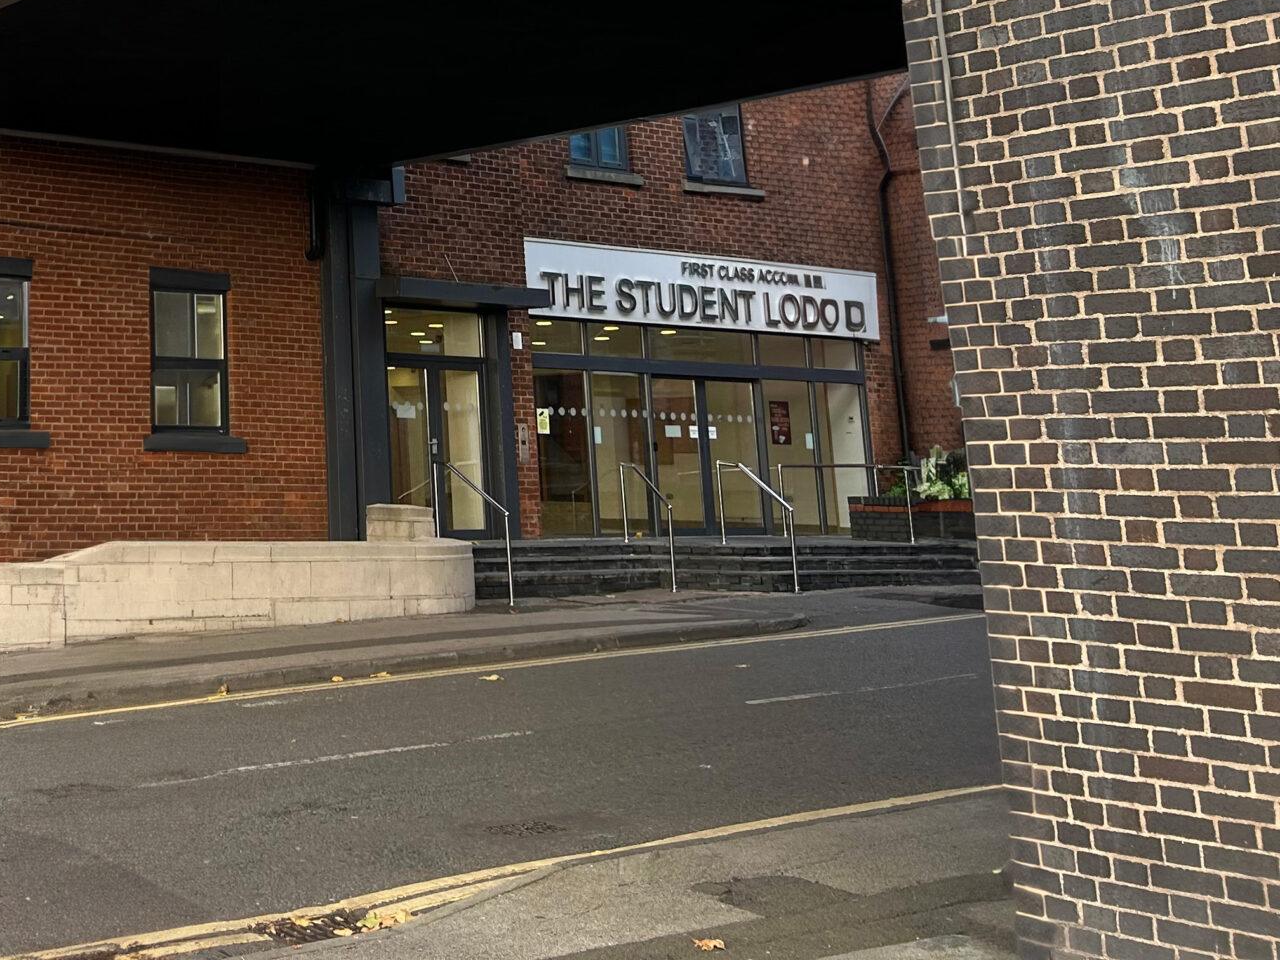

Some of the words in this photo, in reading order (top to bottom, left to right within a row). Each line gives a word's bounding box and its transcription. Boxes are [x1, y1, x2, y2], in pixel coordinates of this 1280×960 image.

[681, 261, 715, 279] FIRST
[717, 265, 755, 283] CLASS
[540, 271, 608, 312] THE
[615, 277, 756, 325] STUDENT
